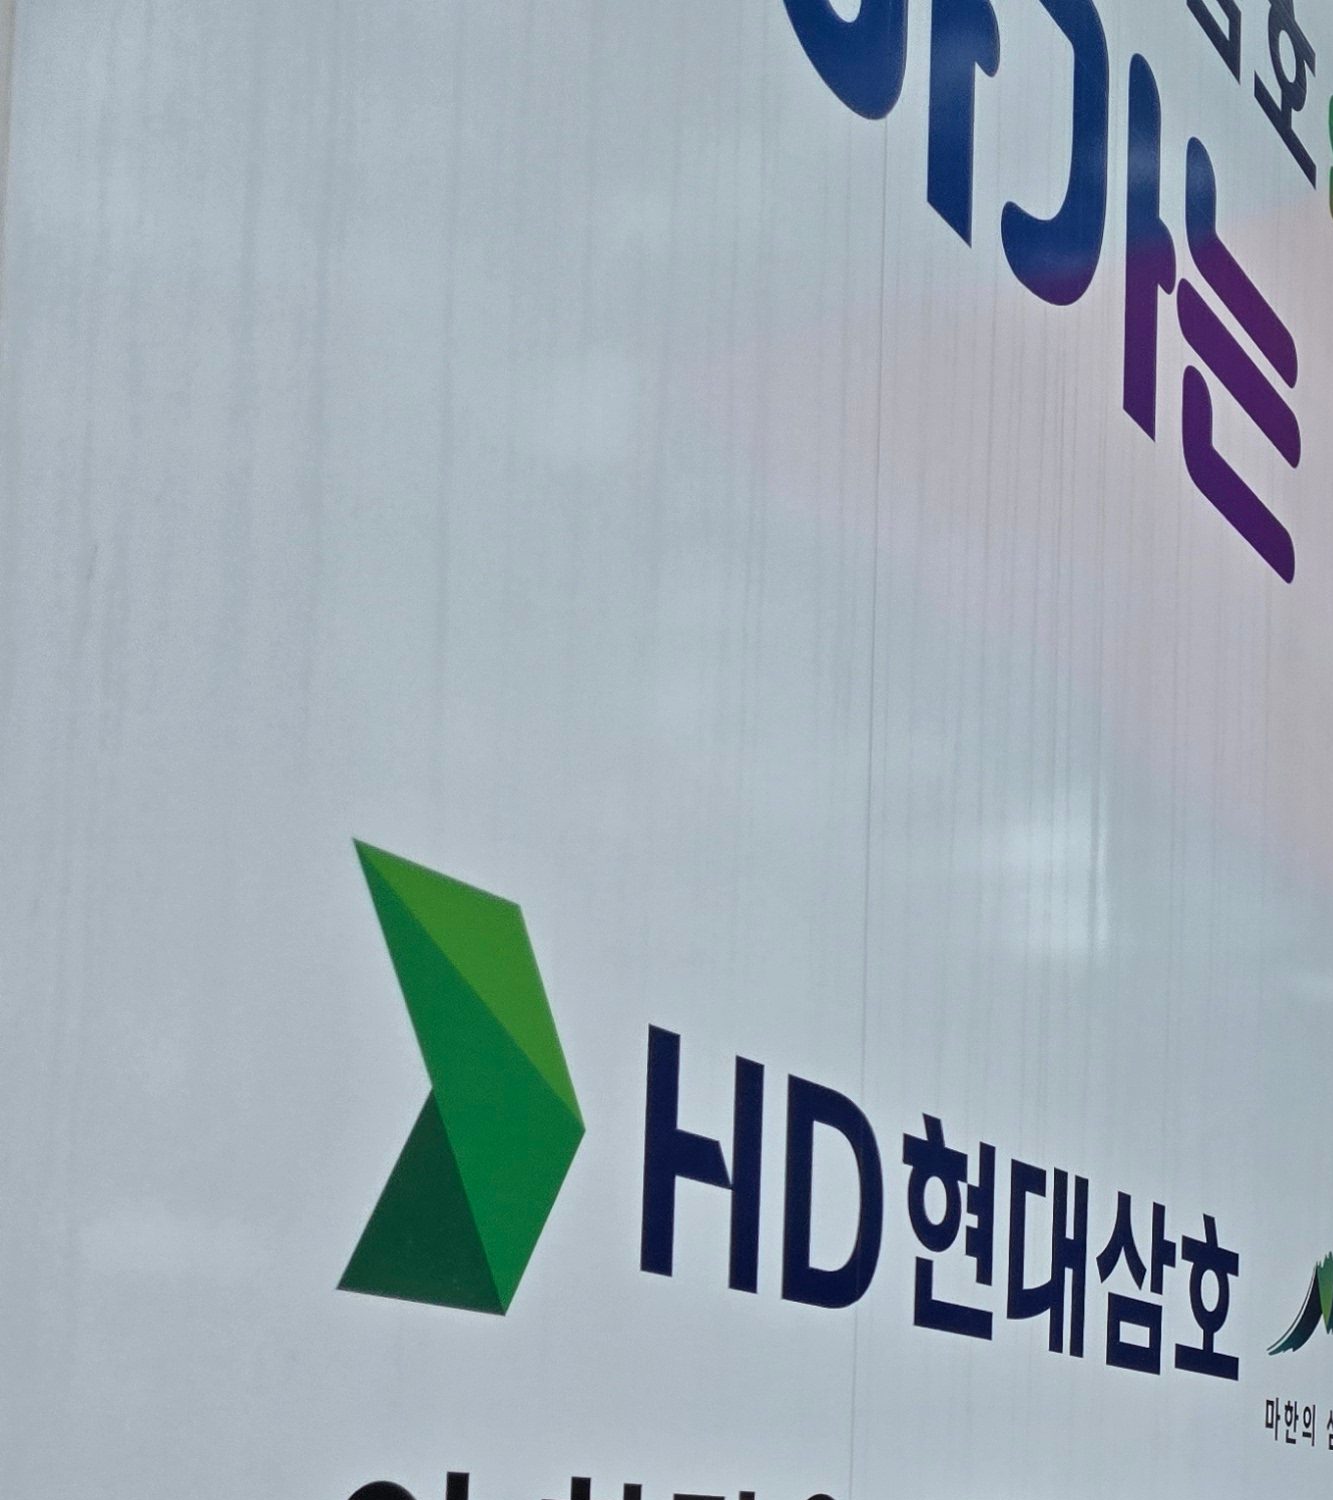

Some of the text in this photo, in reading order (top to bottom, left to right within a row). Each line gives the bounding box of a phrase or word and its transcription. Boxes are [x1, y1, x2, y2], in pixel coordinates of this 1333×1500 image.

[1187, 0, 1316, 190] 호
[640, 1023, 1240, 1381] HD현대삼호
[1264, 1397, 1317, 1447] 마한의
